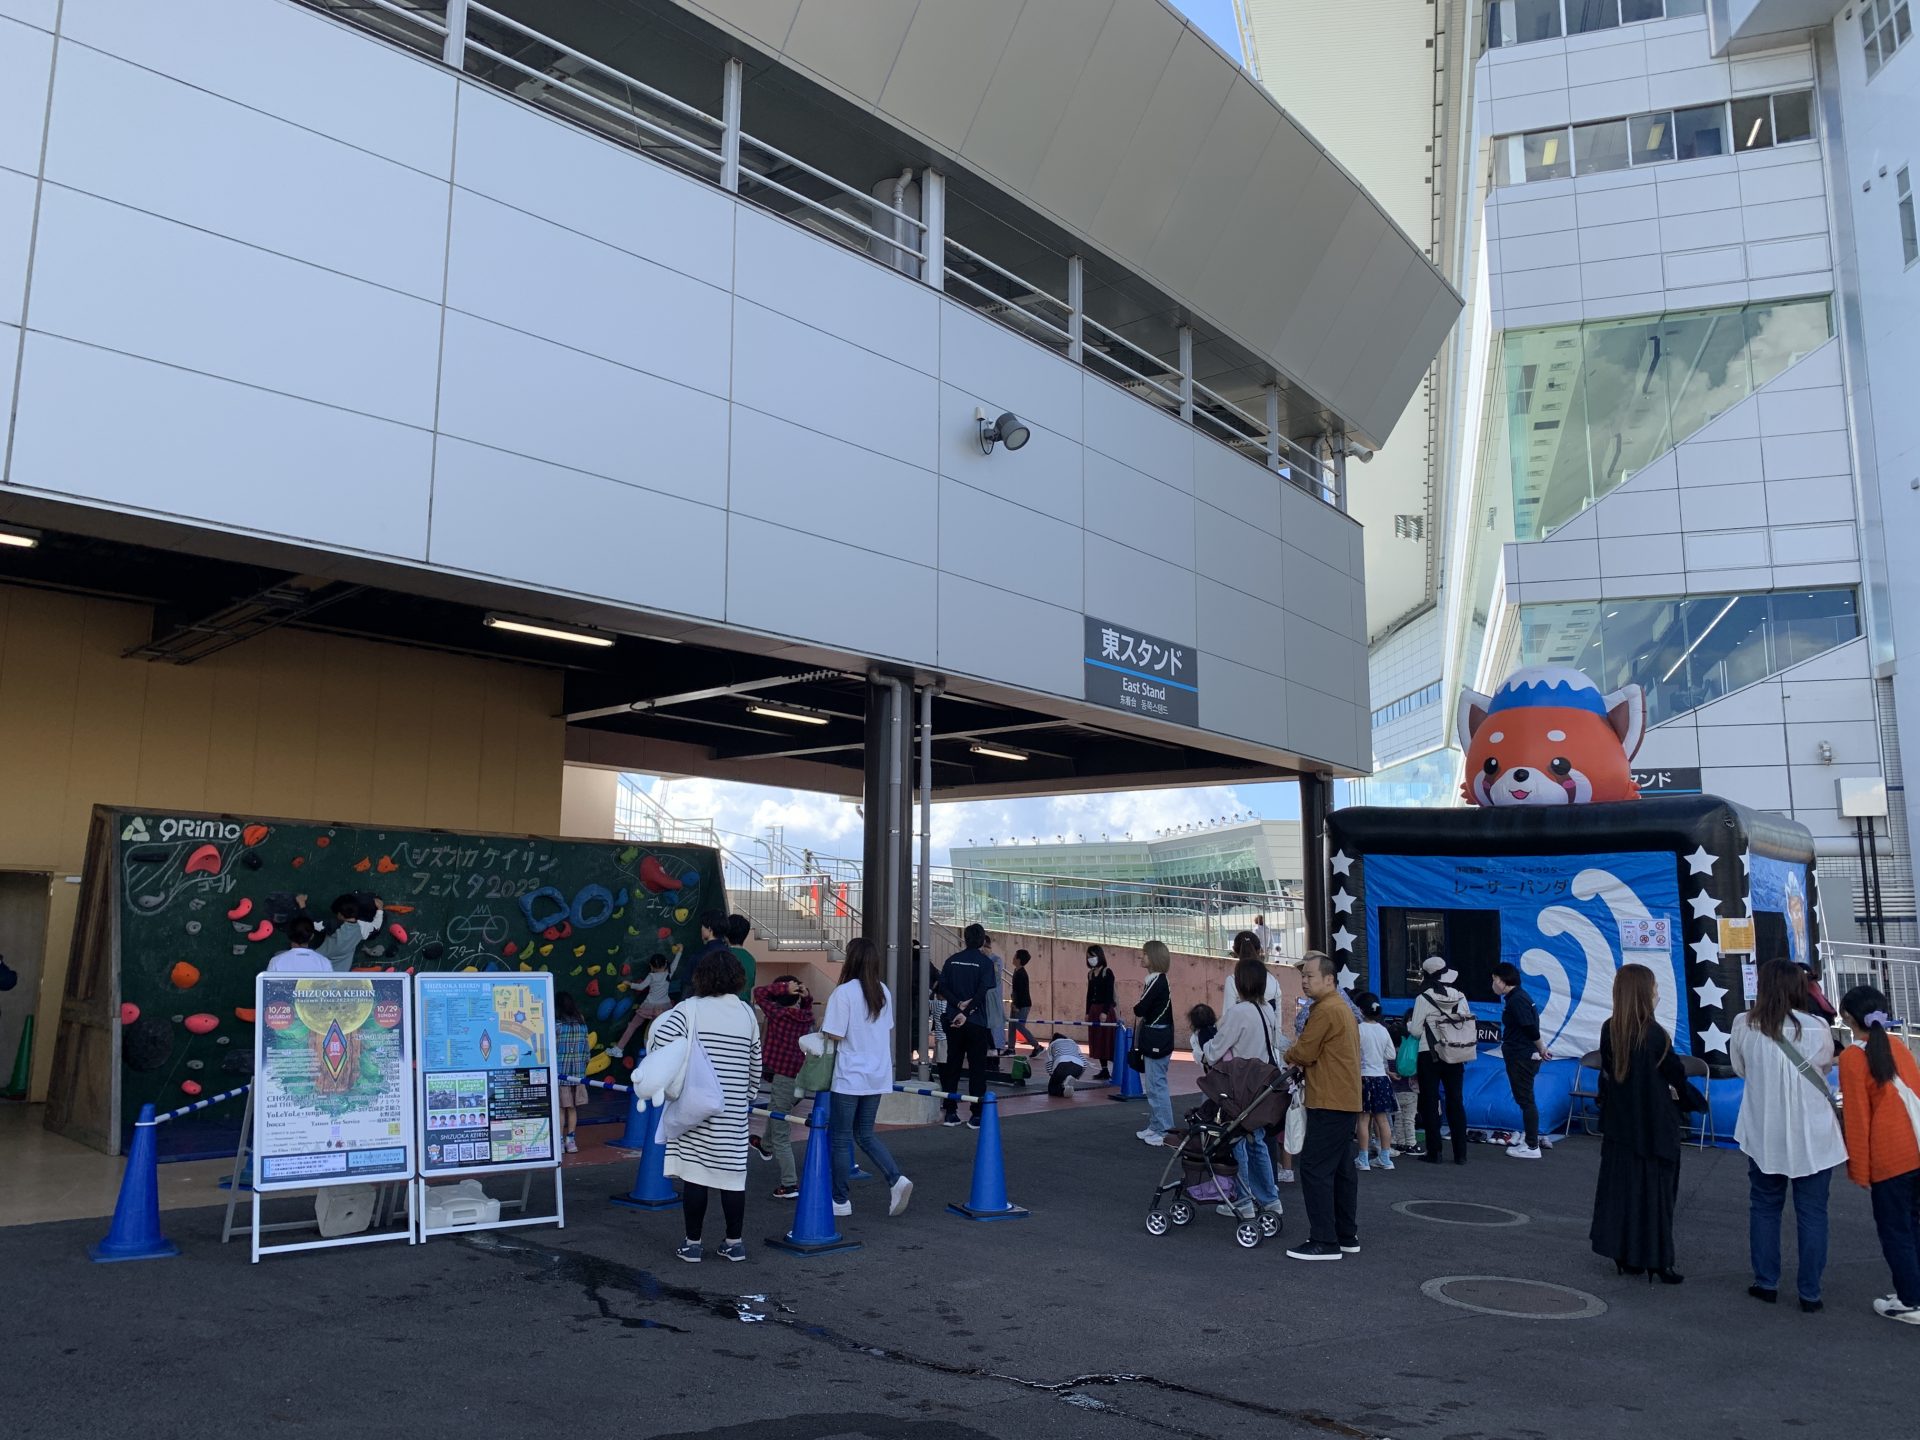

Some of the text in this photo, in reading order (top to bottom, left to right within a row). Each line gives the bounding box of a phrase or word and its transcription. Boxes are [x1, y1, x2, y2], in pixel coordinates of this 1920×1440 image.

[1101, 627, 1183, 676] 東スタンド
[1122, 677, 1166, 700] East Stand
[1455, 879, 1569, 895] レーザーパンダ
[292, 989, 376, 998] SHIZUOKA KEIRIN
[268, 1006, 291, 1014] 10/28
[376, 1005, 398, 1013] 10/29
[1478, 1029, 1499, 1041] RIN
[440, 1133, 470, 1141] SHIZUOKA
